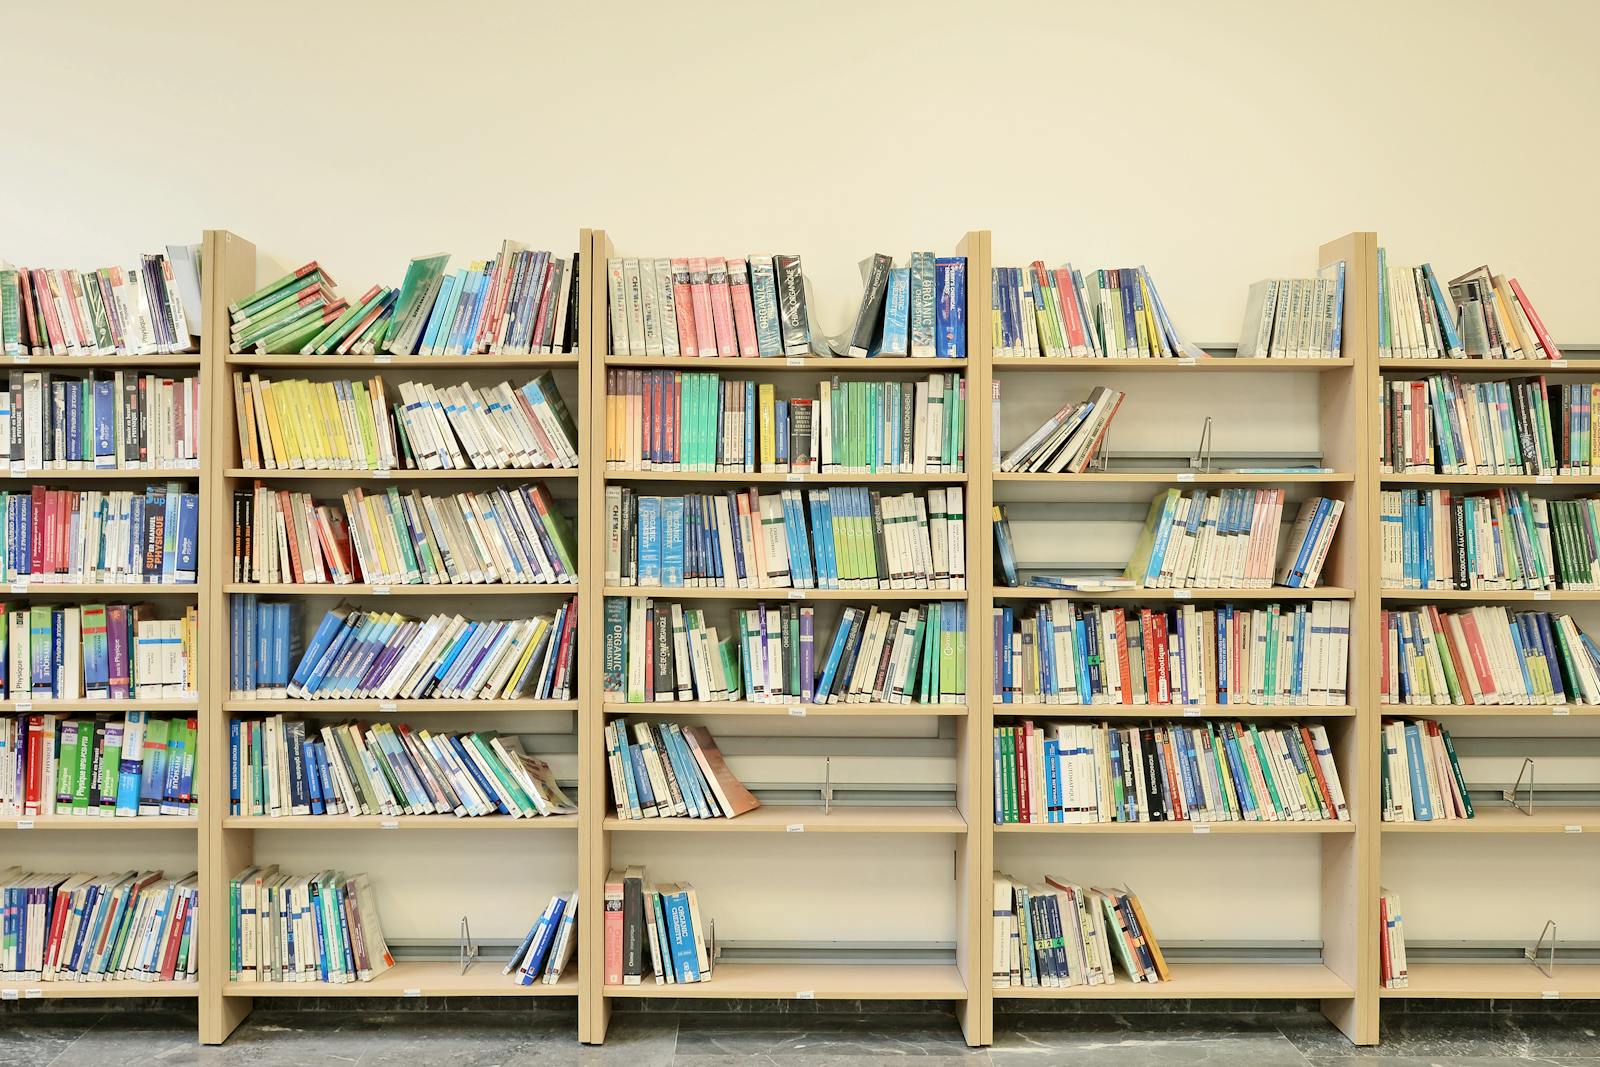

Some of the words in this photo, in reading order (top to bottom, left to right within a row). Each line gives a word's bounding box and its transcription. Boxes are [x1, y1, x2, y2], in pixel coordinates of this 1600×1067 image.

[757, 285, 768, 328] ORGANIC
[923, 280, 933, 325] ORGANIC
[146, 544, 155, 569] SUPER
[155, 516, 163, 564] PHYSIQUE
[1459, 547, 1467, 581] INTRODUCTION
[114, 639, 122, 663] Physique
[613, 625, 622, 671] ORGANIC
[1157, 643, 1167, 681] Robotique
[16, 660, 24, 689] Physique
[76, 770, 88, 796] Physique
[172, 756, 180, 789] PHYSIQUE
[294, 756, 302, 780] générale
[672, 907, 682, 945] CHEMISTRY
[677, 906, 688, 938] ORGANIC
